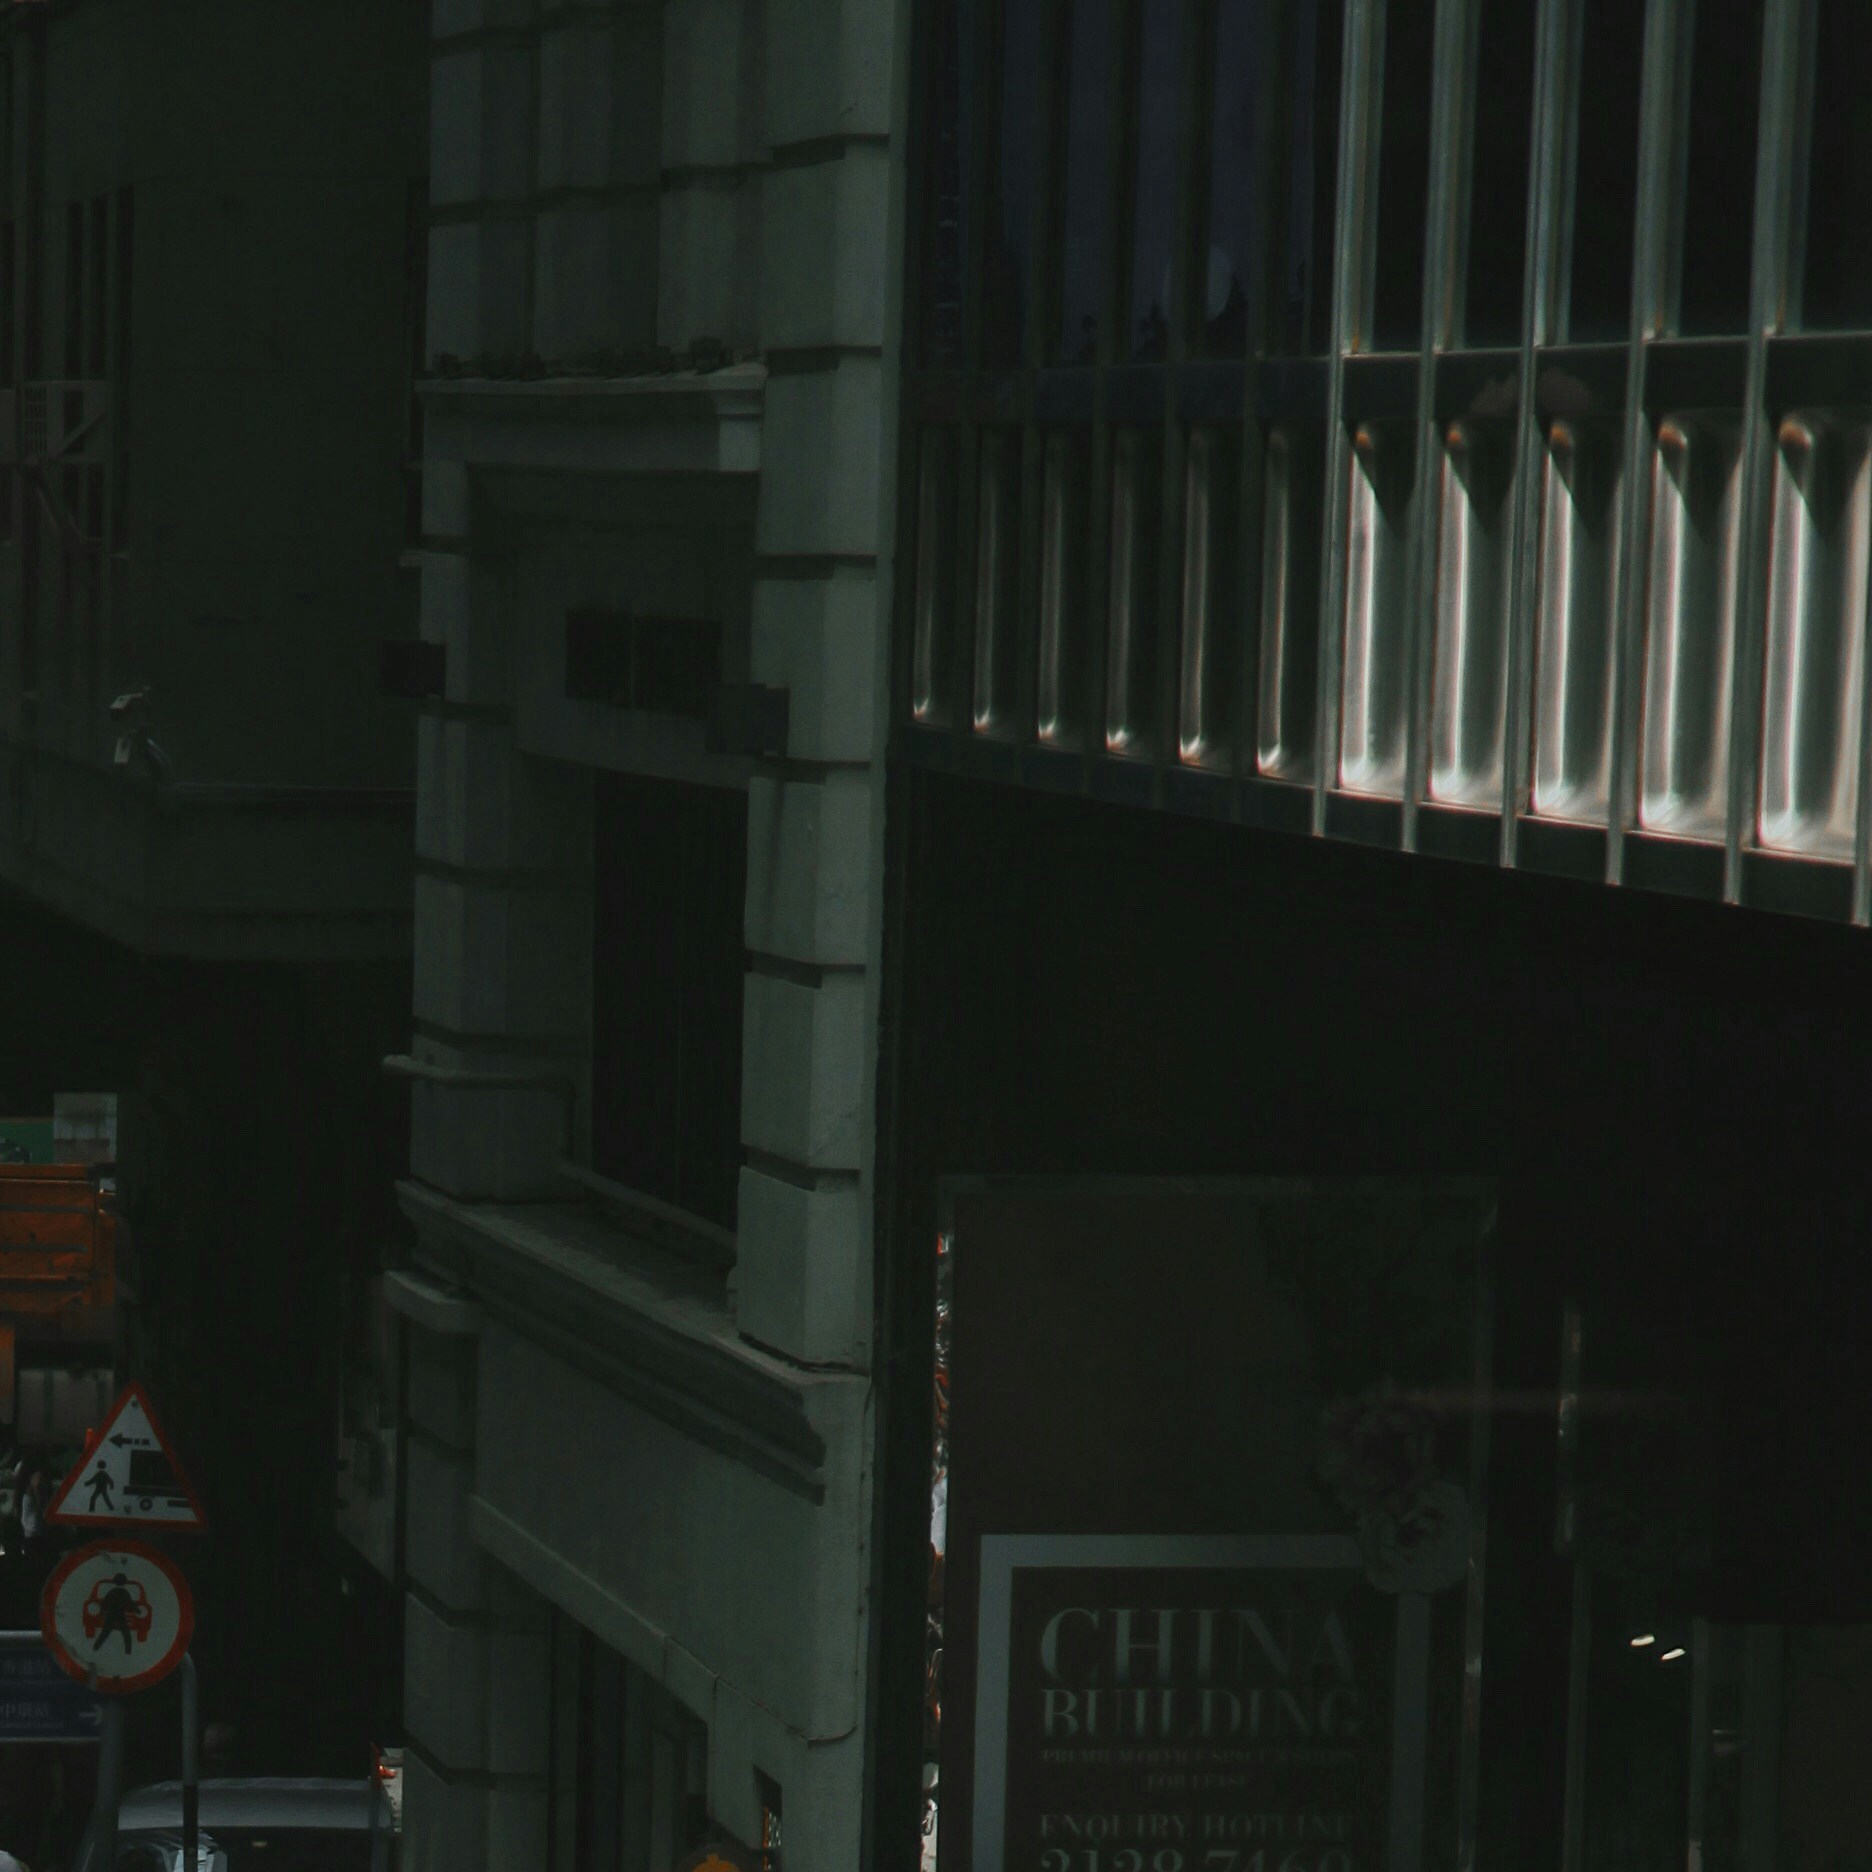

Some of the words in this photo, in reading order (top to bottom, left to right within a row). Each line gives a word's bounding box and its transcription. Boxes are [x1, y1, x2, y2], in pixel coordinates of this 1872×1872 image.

[1040, 1608, 1356, 1684] CHINA
[1040, 1689, 1360, 1738] BUILDING
[1040, 1814, 1186, 1841] ENQUIRY
[1204, 1814, 1355, 1839] HOTLINE
